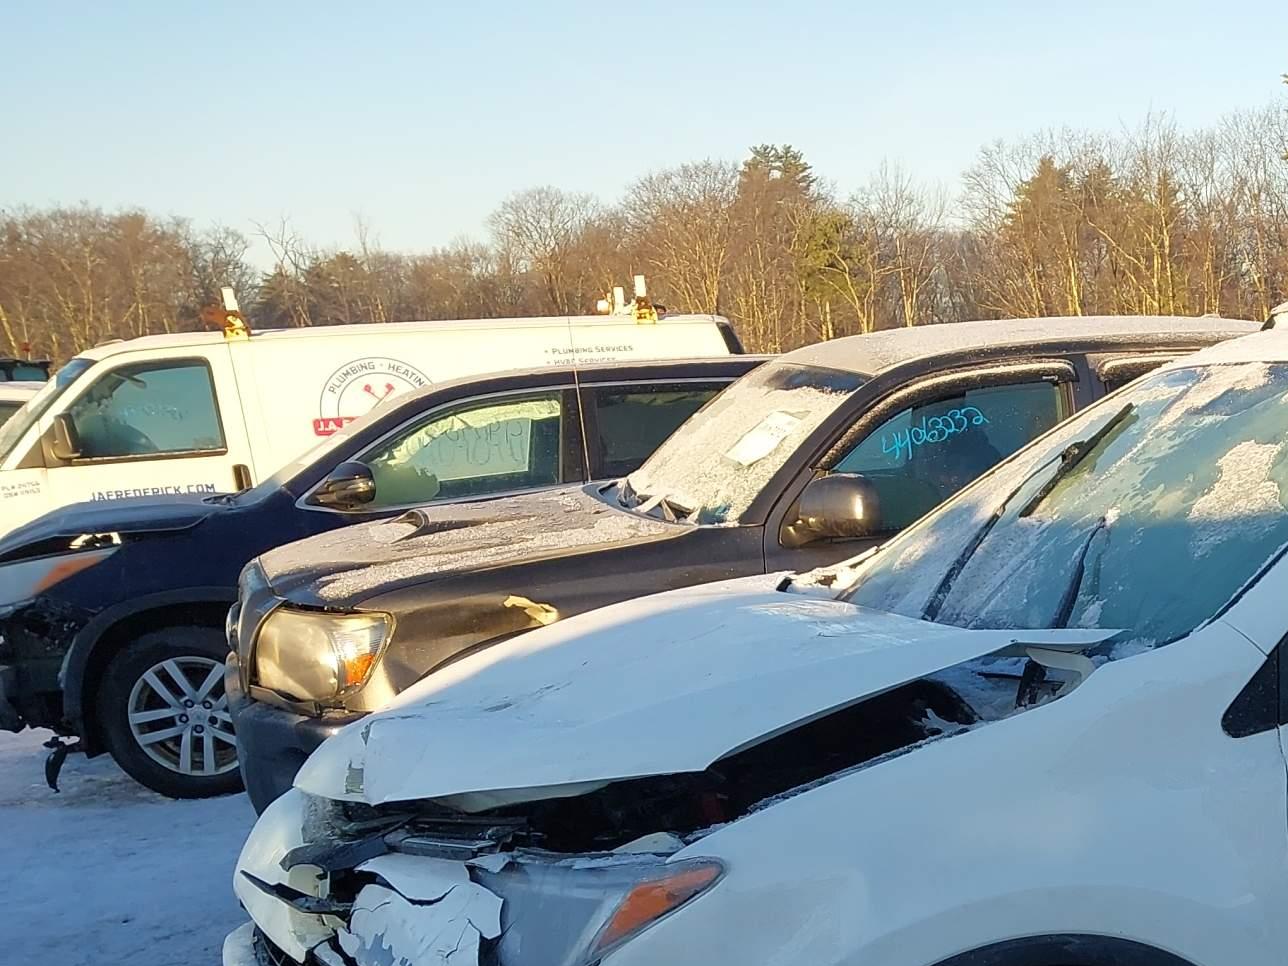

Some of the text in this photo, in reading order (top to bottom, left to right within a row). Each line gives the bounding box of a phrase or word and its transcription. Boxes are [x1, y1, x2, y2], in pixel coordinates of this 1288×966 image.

[552, 347, 593, 355] PLUMBING
[328, 361, 425, 394] PLUMBING HEATIN
[91, 483, 216, 501] JAFREDERICK.COM
